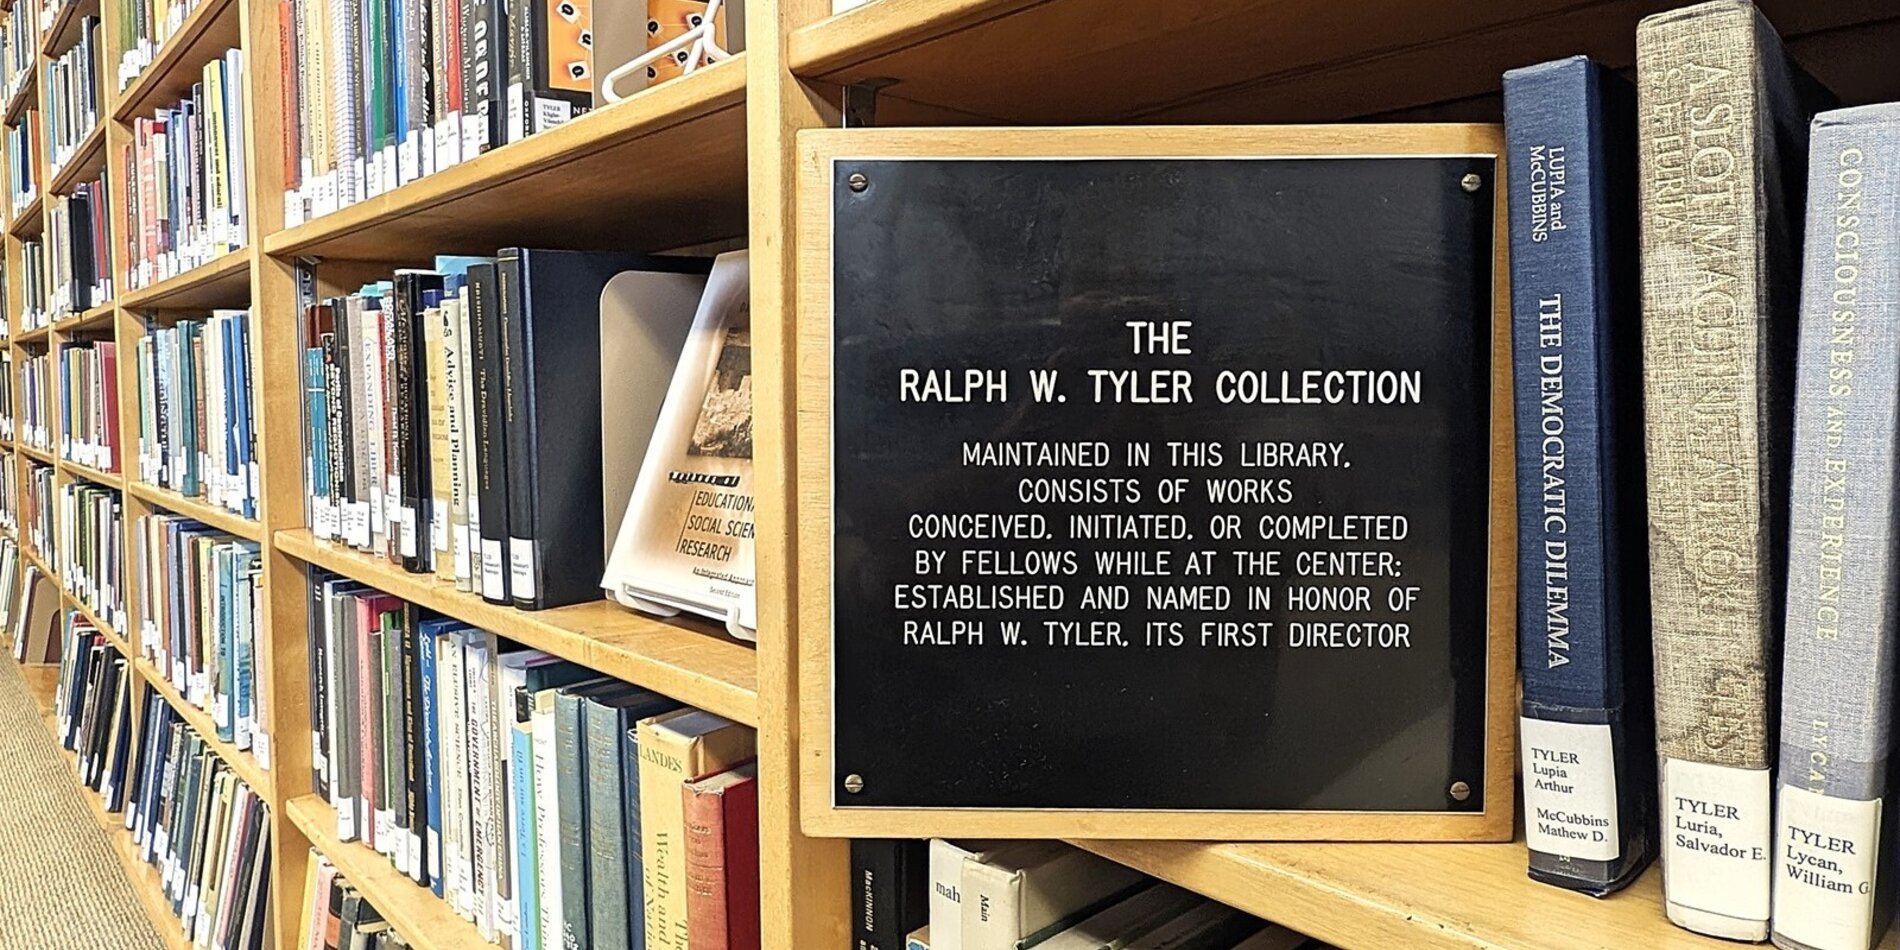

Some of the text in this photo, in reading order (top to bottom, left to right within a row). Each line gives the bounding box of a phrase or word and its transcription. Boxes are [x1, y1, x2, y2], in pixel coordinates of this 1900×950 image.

[1687, 63, 1728, 94] A
[1690, 104, 1736, 207] SLOT
[1530, 145, 1549, 242] McCUBBINS
[1548, 146, 1566, 231] LUPIA and
[1126, 320, 1193, 355] THE
[364, 343, 377, 431] EXPANDING
[900, 369, 1421, 404] RALPH W. TYLER COLLECTION
[1815, 147, 1864, 642] CONSCIOUSNESS AND EXPERIENCE
[444, 346, 462, 507] Advice and Planning
[963, 441, 1110, 467] MAINTAINED
[1127, 442, 1150, 467] IN
[1166, 442, 1223, 467] THIS
[1018, 478, 1293, 504] CONSISTS OF WORKS
[1538, 293, 1571, 669] THE DEMOCRATIC DILEMMA
[687, 514, 722, 535] SOCIAL
[1209, 514, 1242, 540] OR
[1259, 514, 1408, 541] COMPLETED
[679, 538, 733, 562] RESEARCH
[915, 549, 947, 575] BY
[962, 549, 1078, 575] FELLOWS
[1094, 550, 1171, 576] WHILE
[1184, 550, 1217, 576] AT
[1232, 551, 1281, 576] THE
[894, 584, 1421, 612] ESTABLISHED AND NAMED IN HONOR OF
[903, 620, 983, 645] RALPH
[1000, 621, 1028, 646] W.
[1146, 621, 1184, 647] ITS
[1201, 622, 1274, 647] FIRST
[1289, 622, 1411, 648] DIRECTOR
[469, 718, 482, 806] GOVERNMENT
[639, 744, 684, 773] LANDES
[1530, 747, 1580, 765] TYLER
[534, 754, 547, 800] How
[1532, 763, 1568, 780] Lupia
[1534, 778, 1575, 795] Arthur
[1536, 806, 1610, 828] McCubbins
[1675, 796, 1741, 821] TYLER
[1538, 822, 1609, 843] Mathew D.
[1675, 816, 1724, 840] Luria,
[1787, 824, 1857, 856] TYLER
[475, 820, 486, 895] EMERGENCY
[536, 805, 549, 899] Professors
[1675, 835, 1768, 862] Salvador E.
[1786, 845, 1844, 876] Lycan,
[655, 832, 670, 943] Wealth and
[935, 881, 961, 904] mah
[1786, 865, 1853, 894] William
[979, 894, 991, 922] Main
